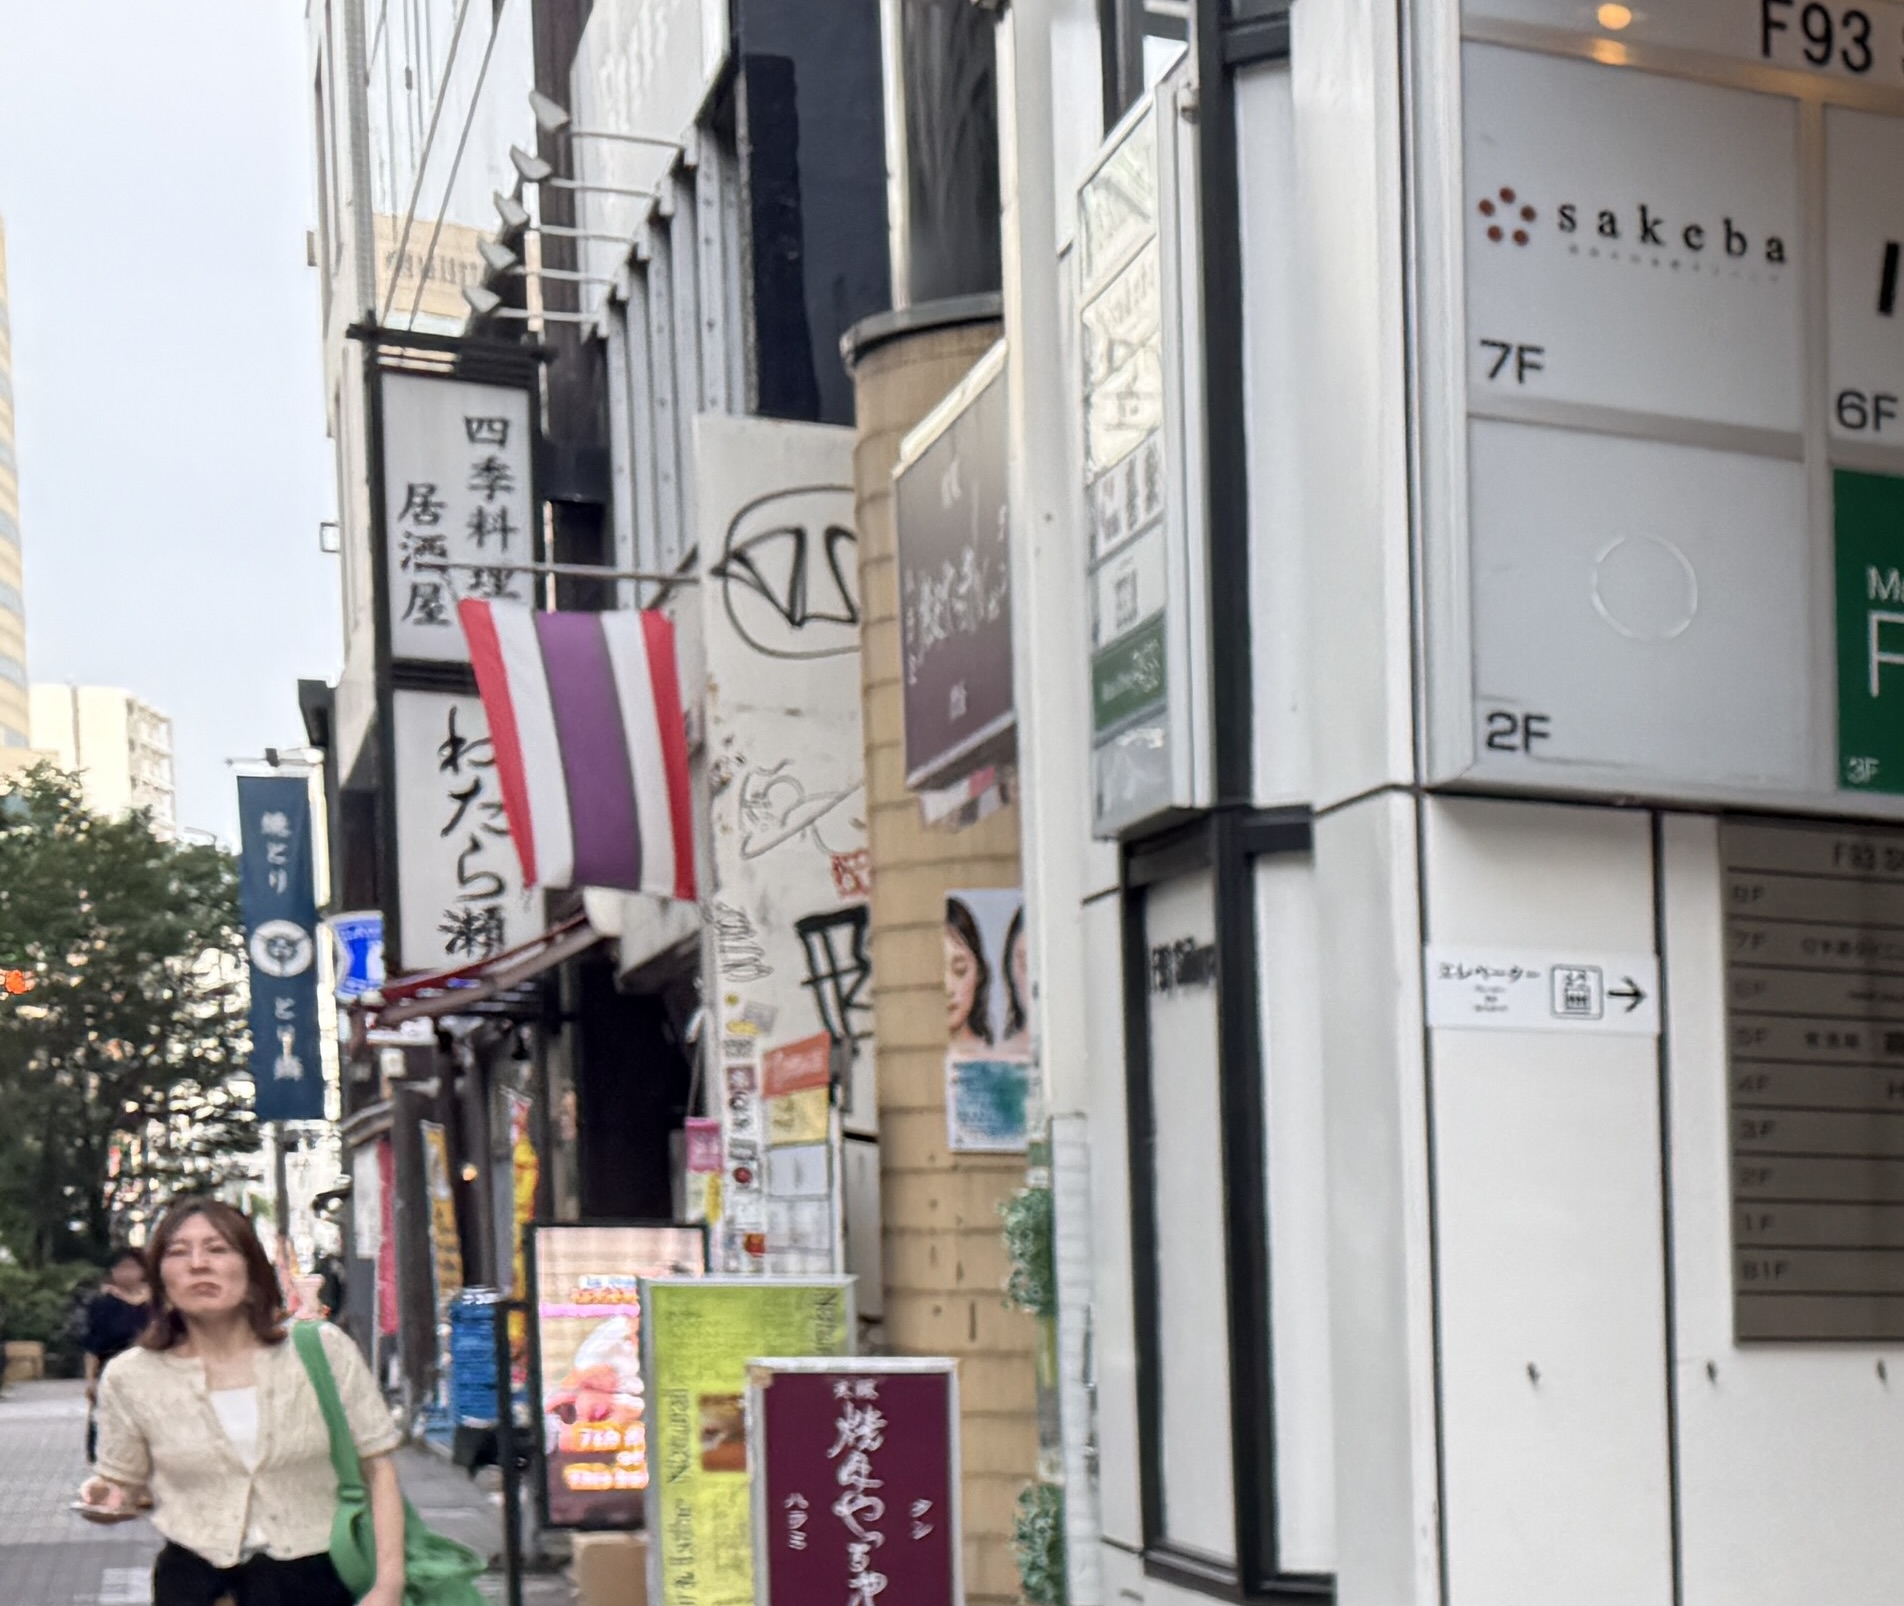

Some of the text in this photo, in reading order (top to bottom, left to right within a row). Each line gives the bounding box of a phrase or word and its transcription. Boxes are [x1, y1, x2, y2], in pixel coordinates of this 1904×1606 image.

[1761, 0, 1873, 73] F93
[1557, 203, 1786, 265] sakeba
[1480, 339, 1545, 383] 7F
[1835, 389, 1899, 432] 6F
[398, 481, 450, 627] 居酒屋
[1484, 711, 1551, 754] 2F
[1847, 756, 1880, 784] 3F
